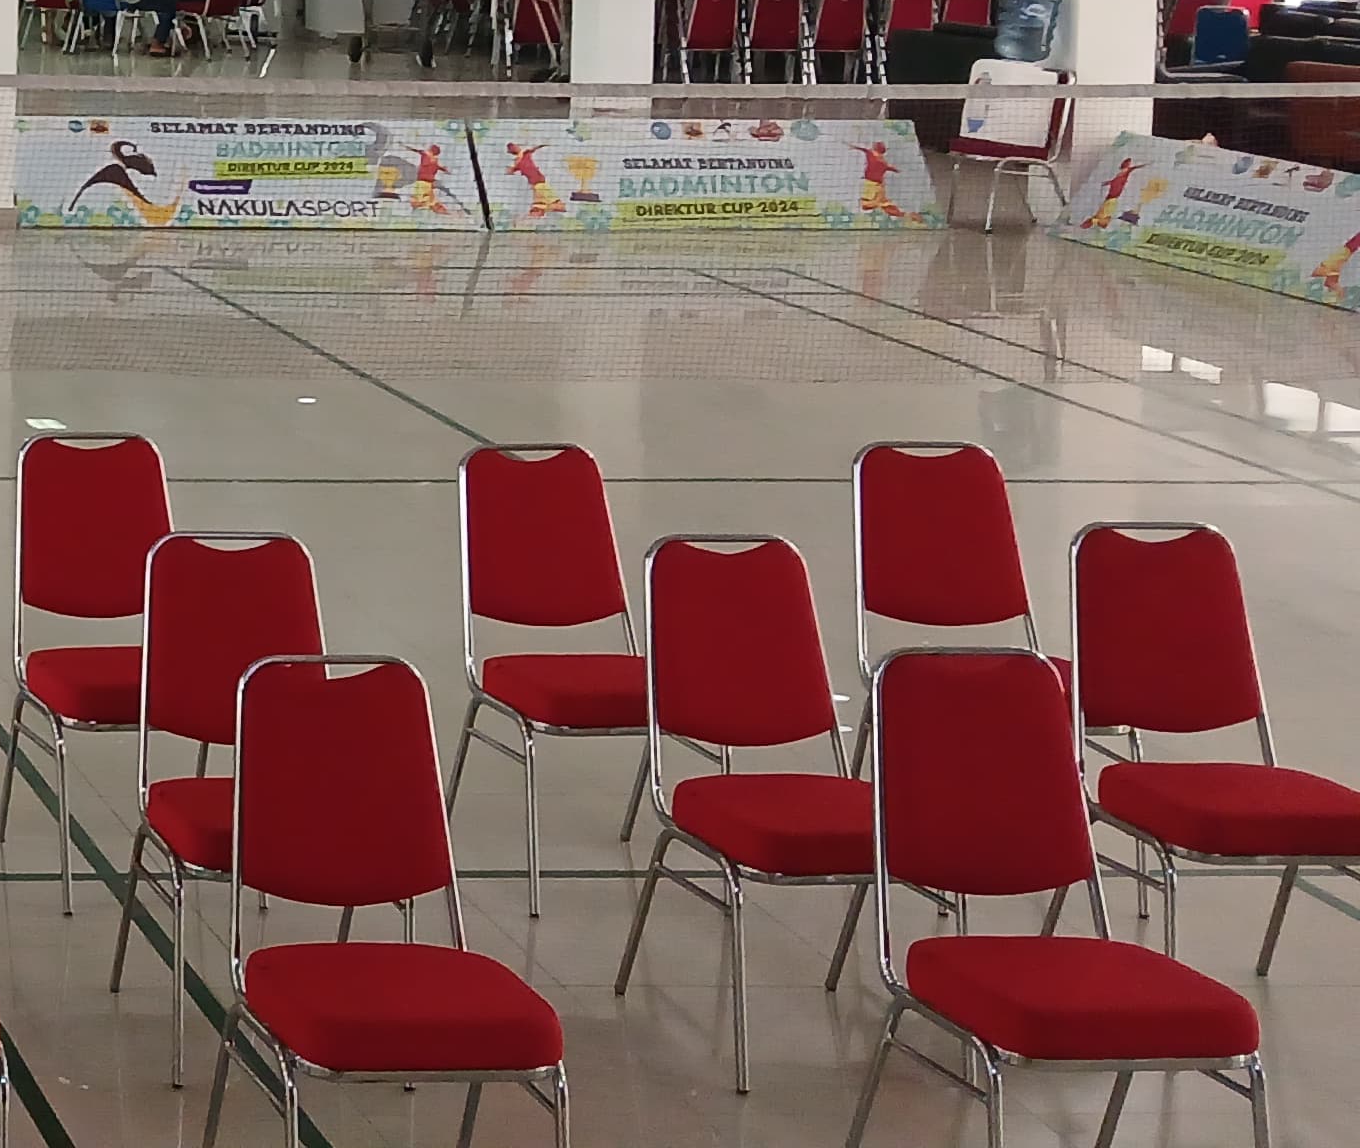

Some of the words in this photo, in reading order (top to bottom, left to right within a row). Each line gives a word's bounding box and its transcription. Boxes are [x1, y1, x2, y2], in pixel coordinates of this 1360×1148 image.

[150, 122, 238, 134] SELAMAT
[245, 123, 366, 136] BERTANDING
[294, 161, 320, 171] CUP
[622, 158, 692, 170] SELAMAT
[618, 172, 810, 198] BADMINTON
[636, 203, 716, 217] DIREKTUR
[722, 202, 752, 214] CUP
[760, 201, 799, 213] 2024
